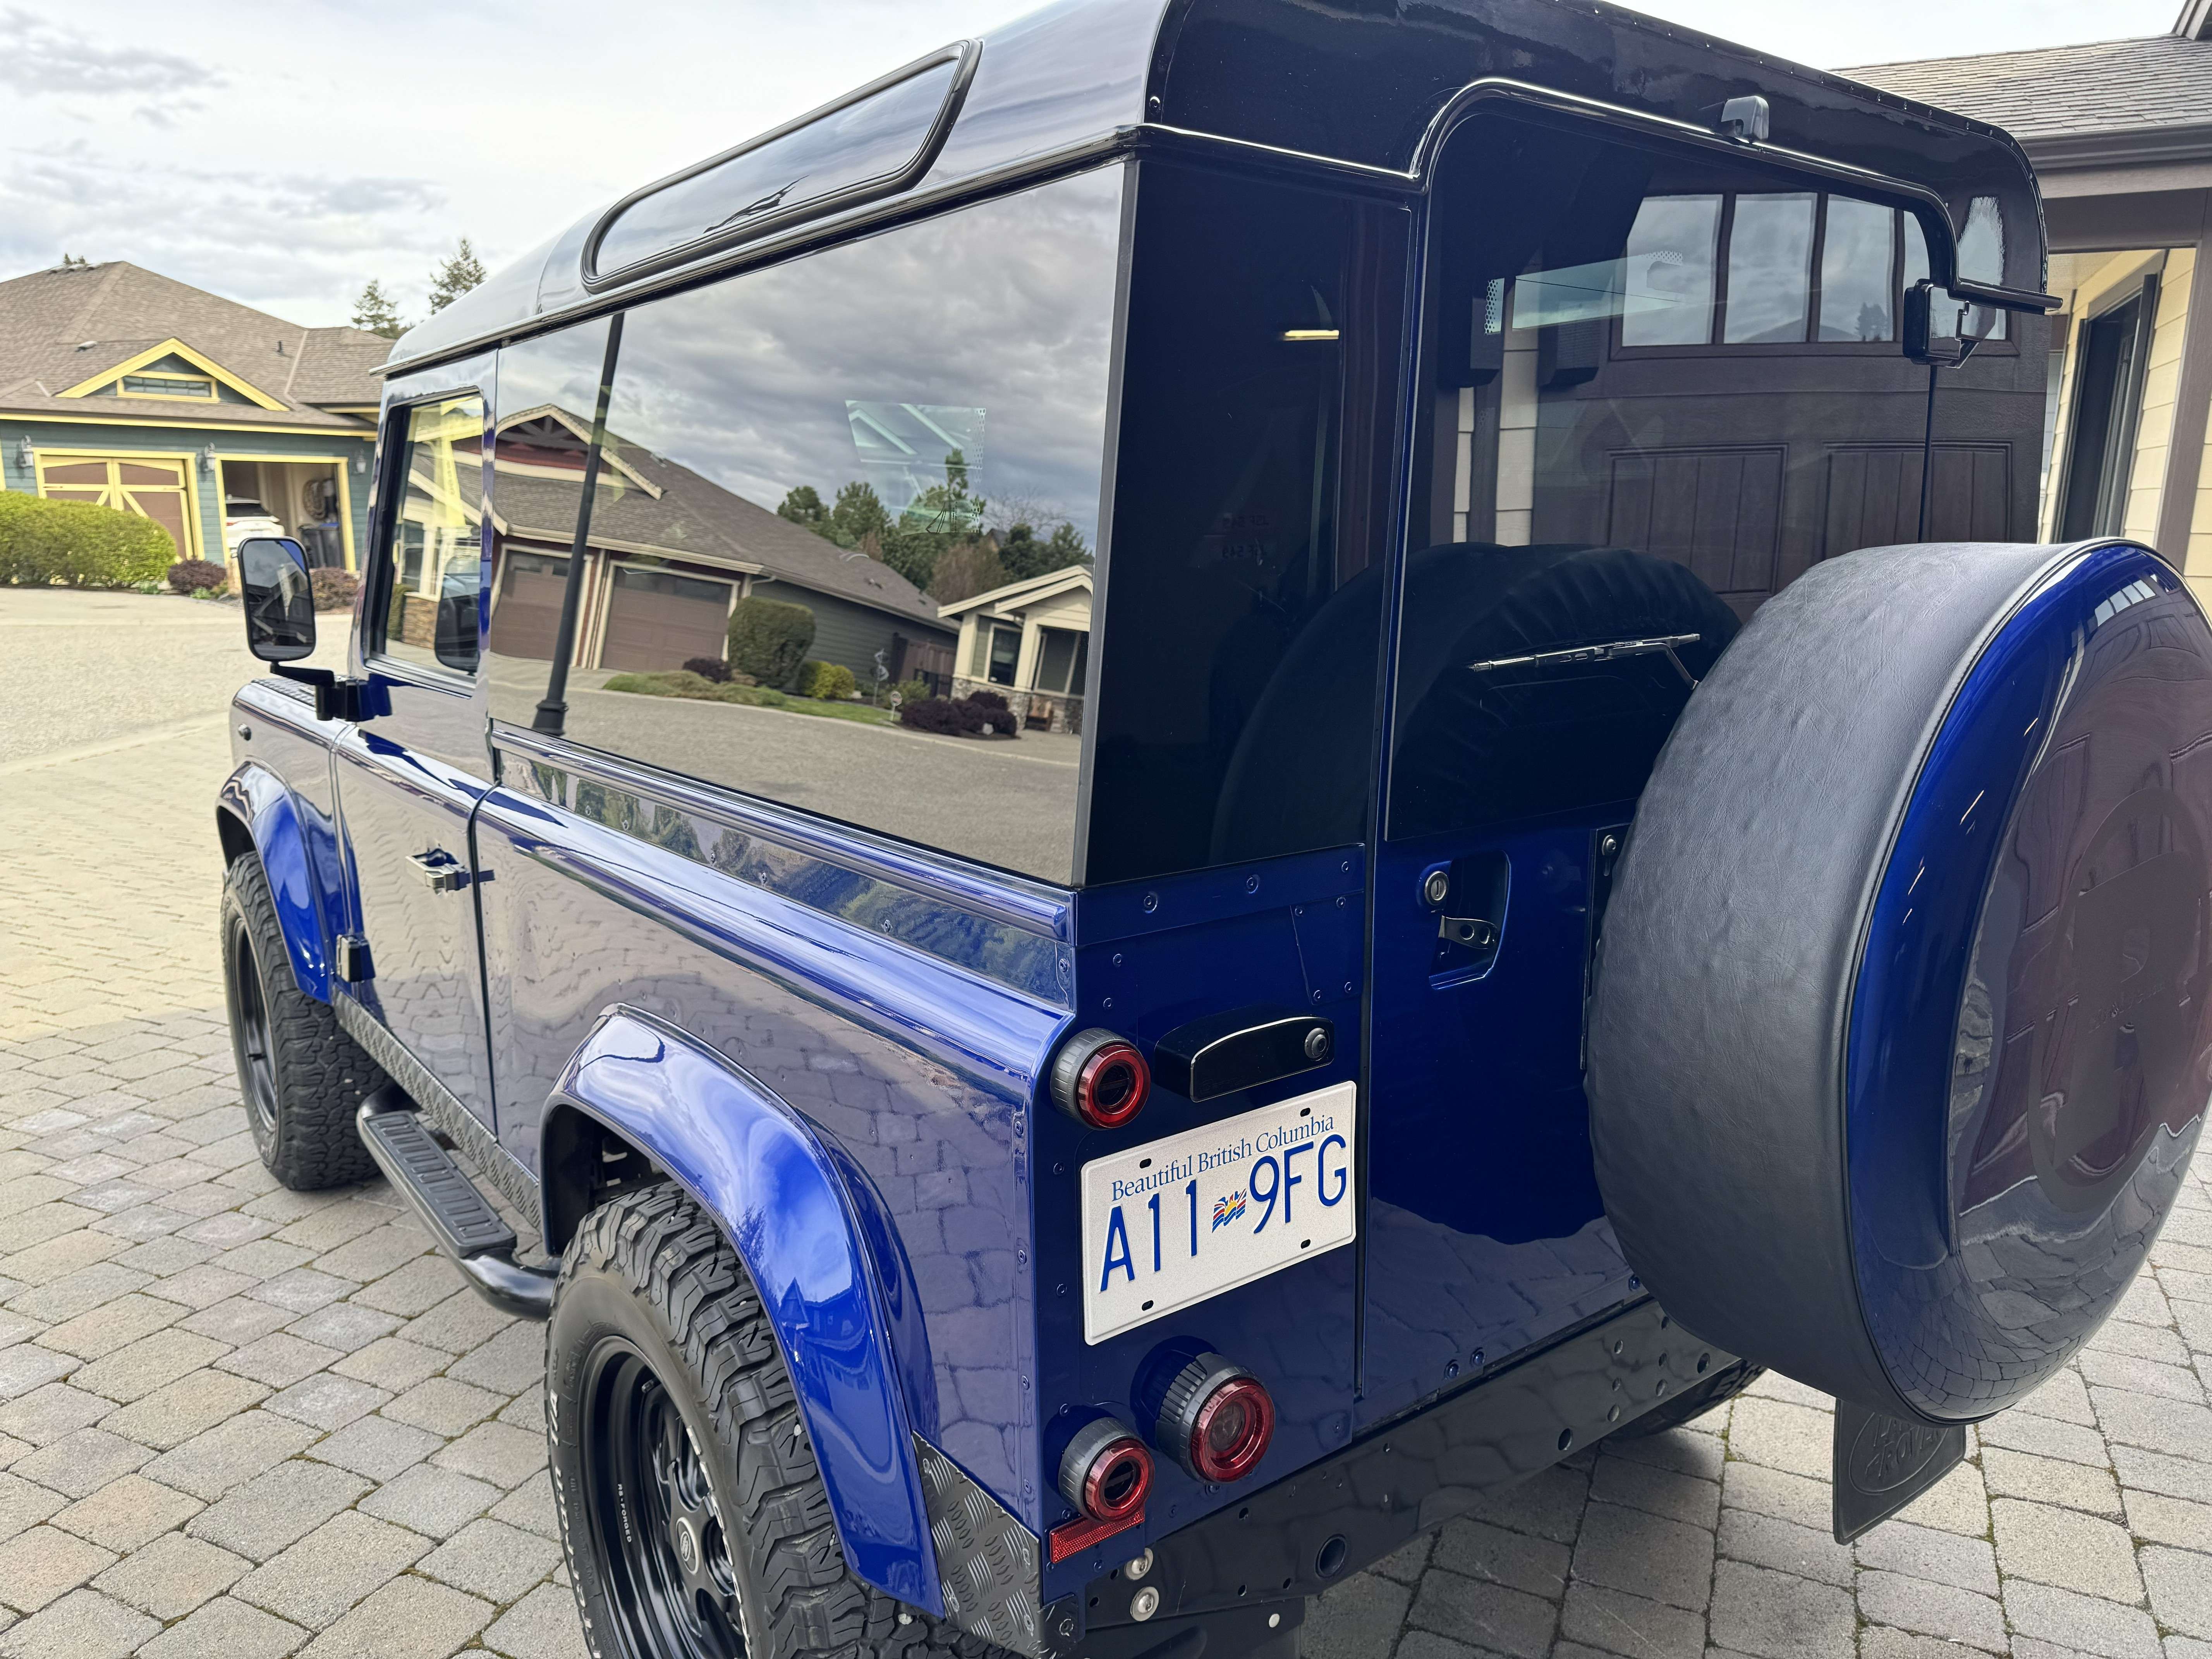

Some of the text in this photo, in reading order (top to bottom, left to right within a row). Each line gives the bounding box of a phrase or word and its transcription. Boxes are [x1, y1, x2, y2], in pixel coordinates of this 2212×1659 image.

[1100, 1134, 1346, 1291] A11 9FG
[1112, 1115, 1334, 1201] Beautiful British Columbia
